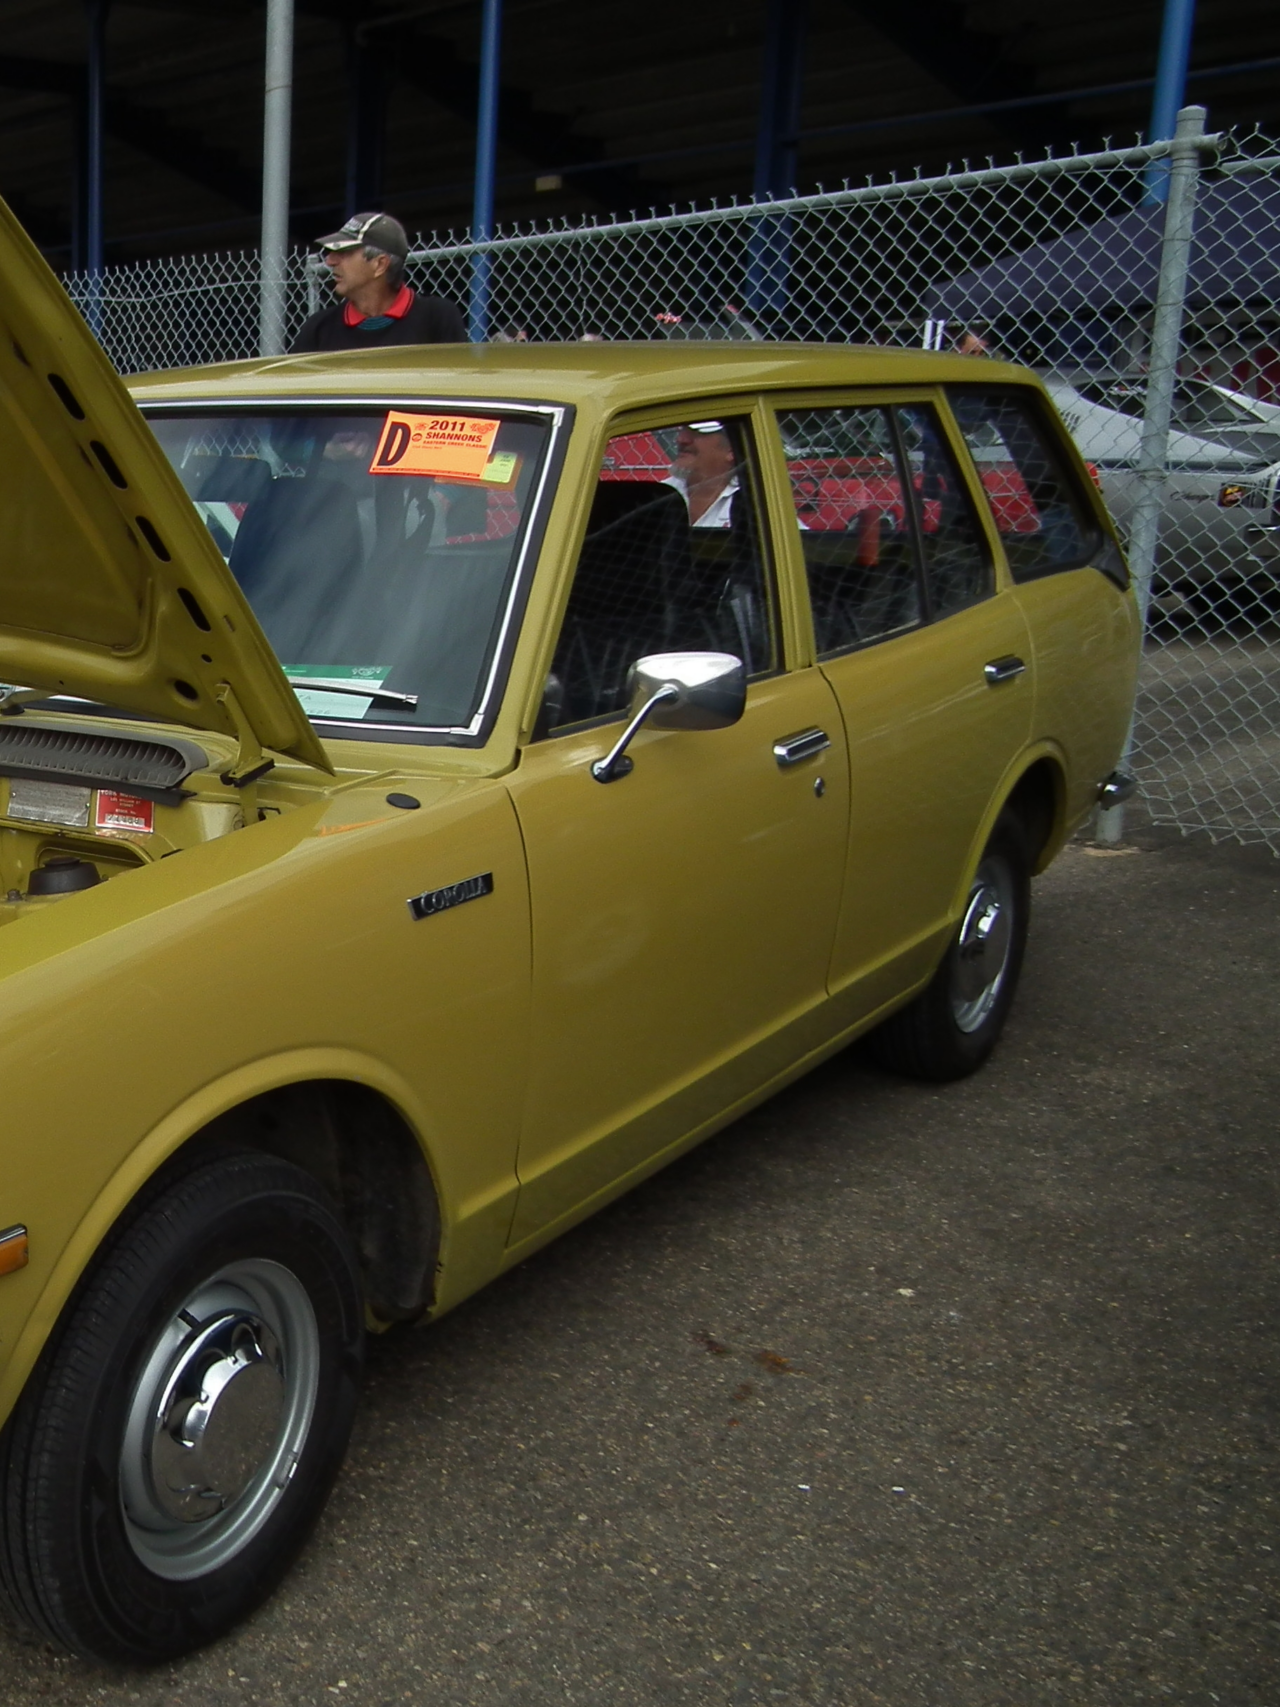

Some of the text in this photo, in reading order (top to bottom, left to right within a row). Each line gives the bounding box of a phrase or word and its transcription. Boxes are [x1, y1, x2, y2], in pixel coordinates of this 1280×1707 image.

[428, 419, 466, 432] 2011
[425, 431, 483, 443] SHANNONS
[376, 421, 412, 467] D
